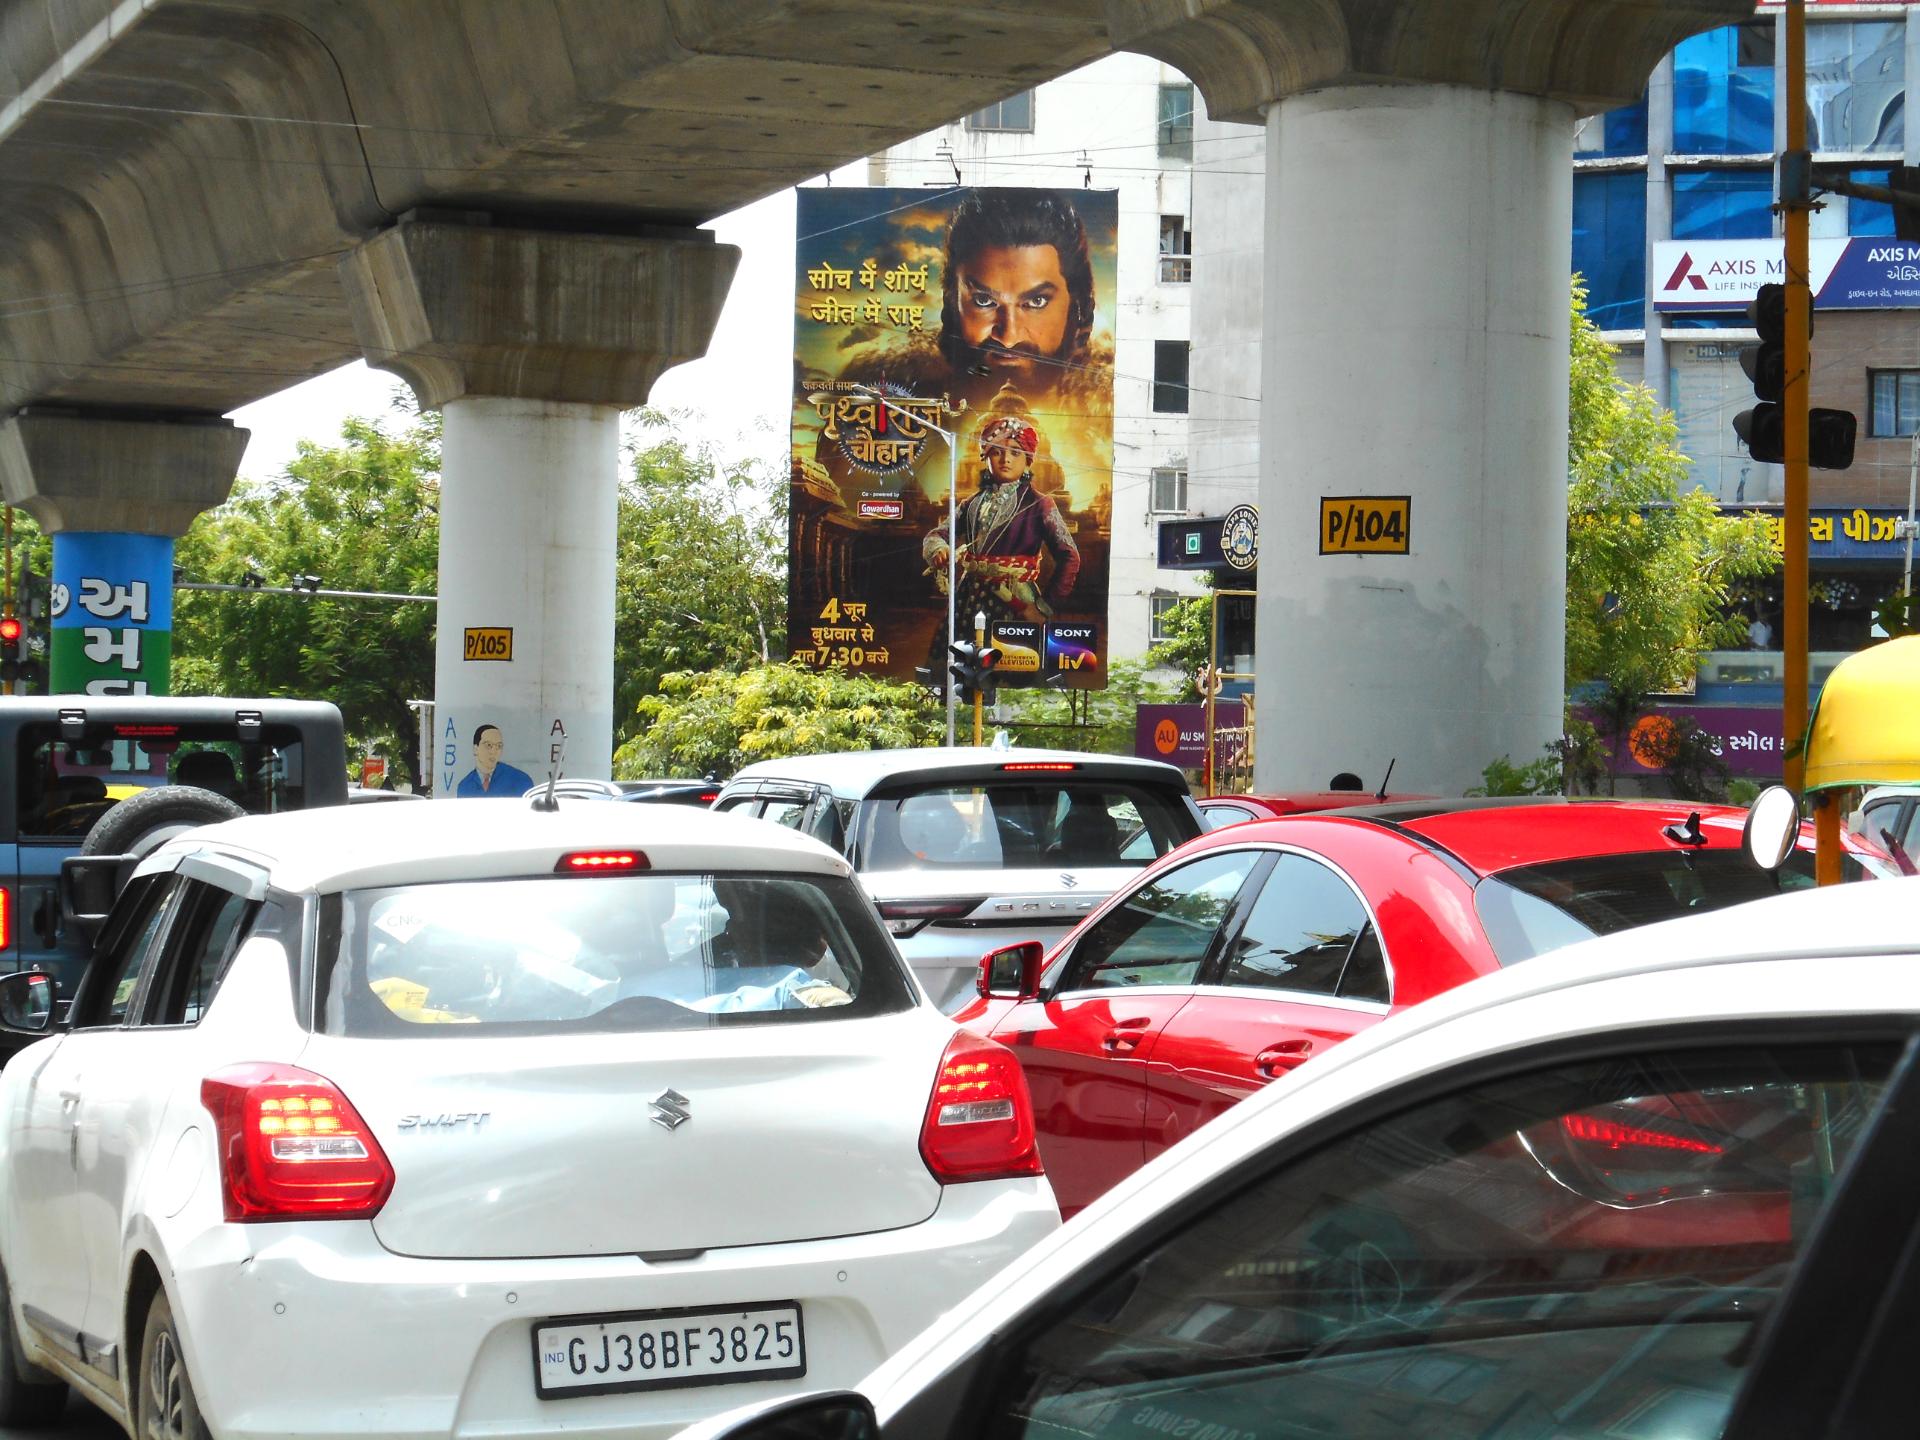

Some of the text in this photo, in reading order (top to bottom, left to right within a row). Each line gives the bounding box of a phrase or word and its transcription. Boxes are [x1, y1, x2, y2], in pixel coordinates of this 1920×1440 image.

[1867, 247, 1905, 262] AXIS
[808, 261, 928, 292] सोच में शौर्य
[1708, 260, 1756, 275] AXIS
[1715, 282, 1736, 290] LIFE
[811, 296, 924, 332] जीत में राष्ट्र
[846, 426, 920, 465] चौहान
[861, 503, 900, 513] Gowardhan
[1328, 504, 1405, 548] P/104
[1842, 509, 1896, 542] પીઝ
[1231, 554, 1254, 567] PIZZA
[820, 597, 867, 624] 4 जून
[811, 623, 874, 646] बुधवार से
[998, 627, 1036, 636] SONY
[1054, 629, 1092, 638] SONY
[467, 632, 507, 657] P/105
[818, 646, 864, 666] 7:30
[866, 646, 890, 664] बजे
[1157, 730, 1175, 743] AU
[1180, 731, 1192, 742] AU
[1729, 730, 1774, 750] સ્મોલ
[398, 1113, 491, 1128] SWIFT
[544, 1321, 793, 1375] IND GJ38BF3825
